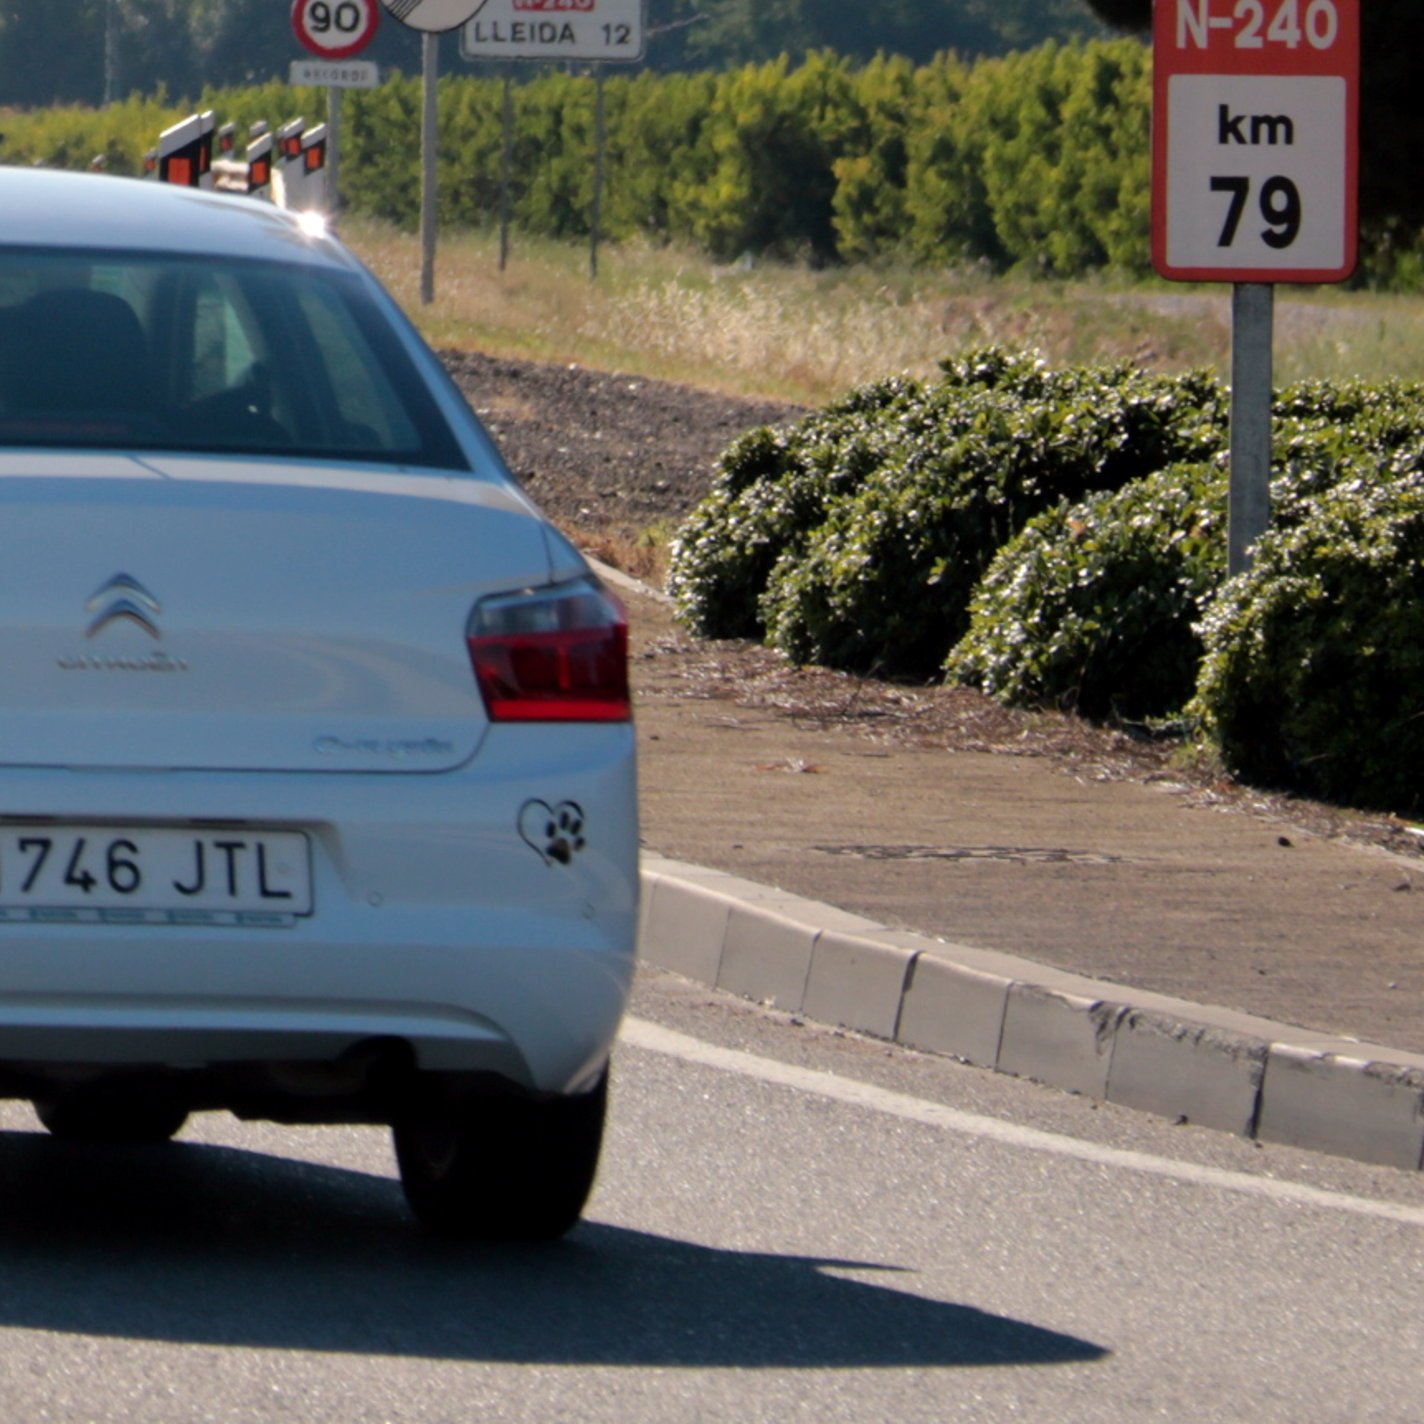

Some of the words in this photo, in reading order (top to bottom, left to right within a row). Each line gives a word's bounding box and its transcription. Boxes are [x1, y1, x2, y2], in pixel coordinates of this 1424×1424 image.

[310, 1, 360, 32] 90
[475, 21, 576, 44] LLEIDA
[601, 23, 631, 45] 12
[1218, 104, 1294, 145] km
[1210, 175, 1302, 250] 79
[172, 839, 293, 900] JTL
